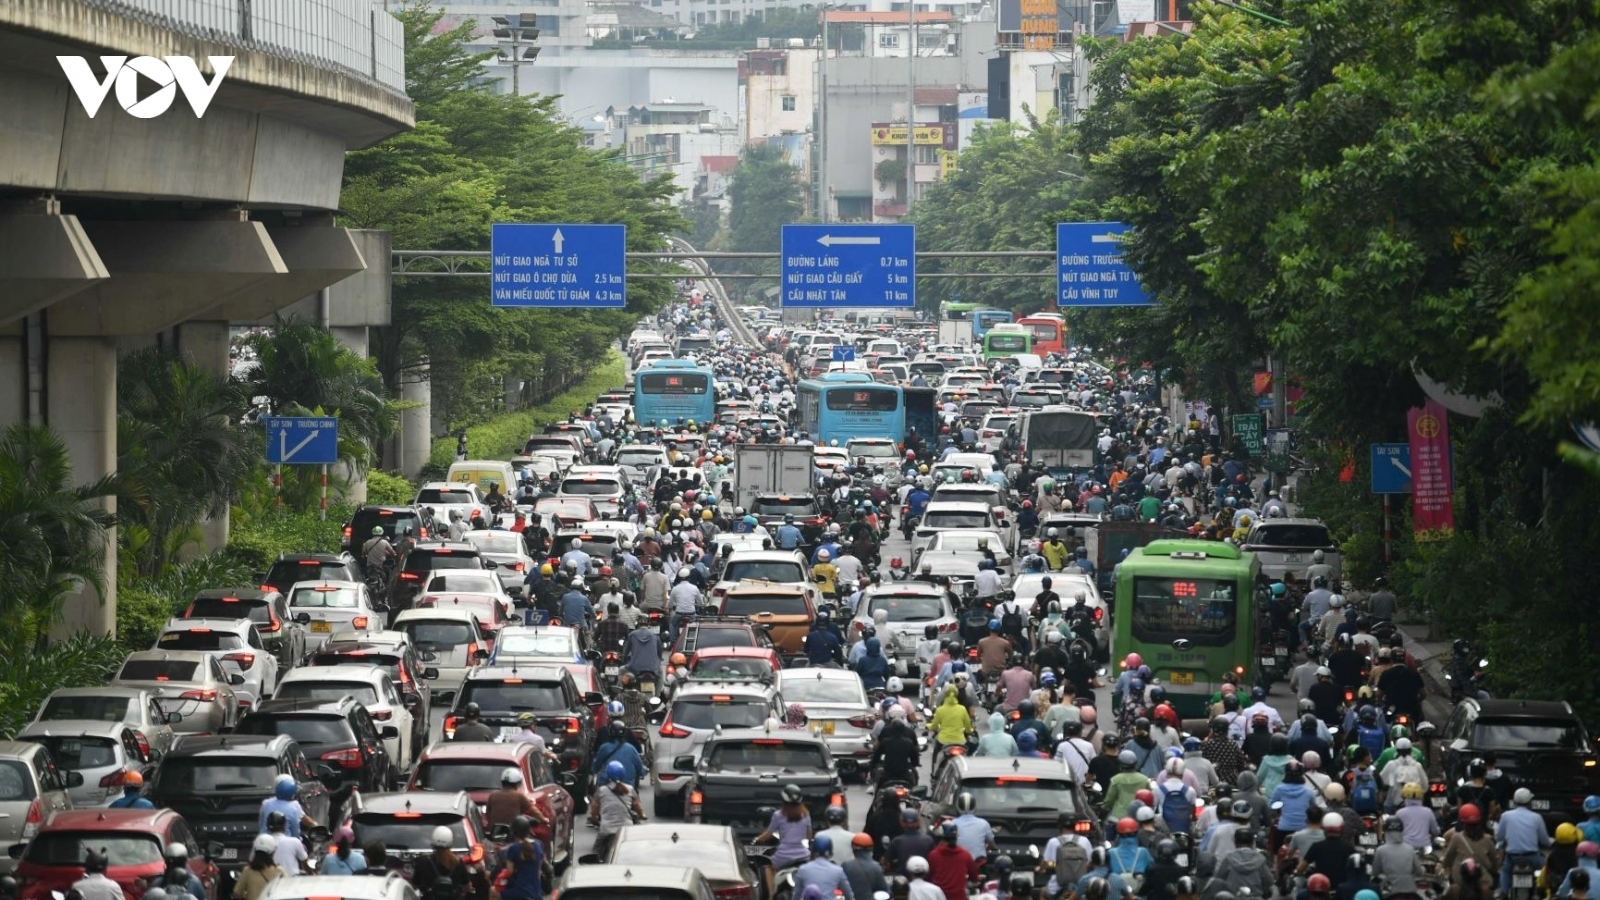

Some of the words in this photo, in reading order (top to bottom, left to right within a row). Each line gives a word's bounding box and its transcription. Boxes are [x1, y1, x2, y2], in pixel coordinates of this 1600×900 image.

[495, 253, 510, 266] NÚT
[513, 256, 531, 266] GIAO
[534, 254, 550, 266] NGÃ
[554, 256, 564, 266] TƯ
[788, 255, 815, 267] ĐƯỜNG
[818, 254, 839, 267] LÁNG
[895, 257, 907, 267] km
[1062, 253, 1089, 266] ĐƯỜNG
[495, 270, 510, 283] NÚT
[513, 273, 531, 283] GIAO
[542, 273, 558, 284] CHỢ
[561, 271, 577, 283] DỪA
[610, 274, 621, 283] km
[788, 271, 804, 284] NÚT
[806, 274, 824, 284] GIAO
[845, 271, 863, 284] GIẤY
[887, 274, 893, 283] 5
[895, 274, 907, 283] km
[1062, 270, 1078, 282] NÚT
[1080, 272, 1098, 282] GIAO
[1101, 270, 1117, 282] NGÃ
[1119, 271, 1130, 281] TƯ
[496, 288, 510, 299] VĂN
[513, 287, 532, 299] MIẾU
[534, 287, 555, 300] QUỐC
[570, 288, 590, 300] GIÁM
[610, 291, 621, 300] km
[807, 289, 827, 302] NHẬT
[830, 289, 846, 300] TÂN
[885, 291, 893, 300] 11
[895, 291, 907, 300] km
[1081, 287, 1100, 299] VĨNH
[1103, 289, 1119, 299] TUY
